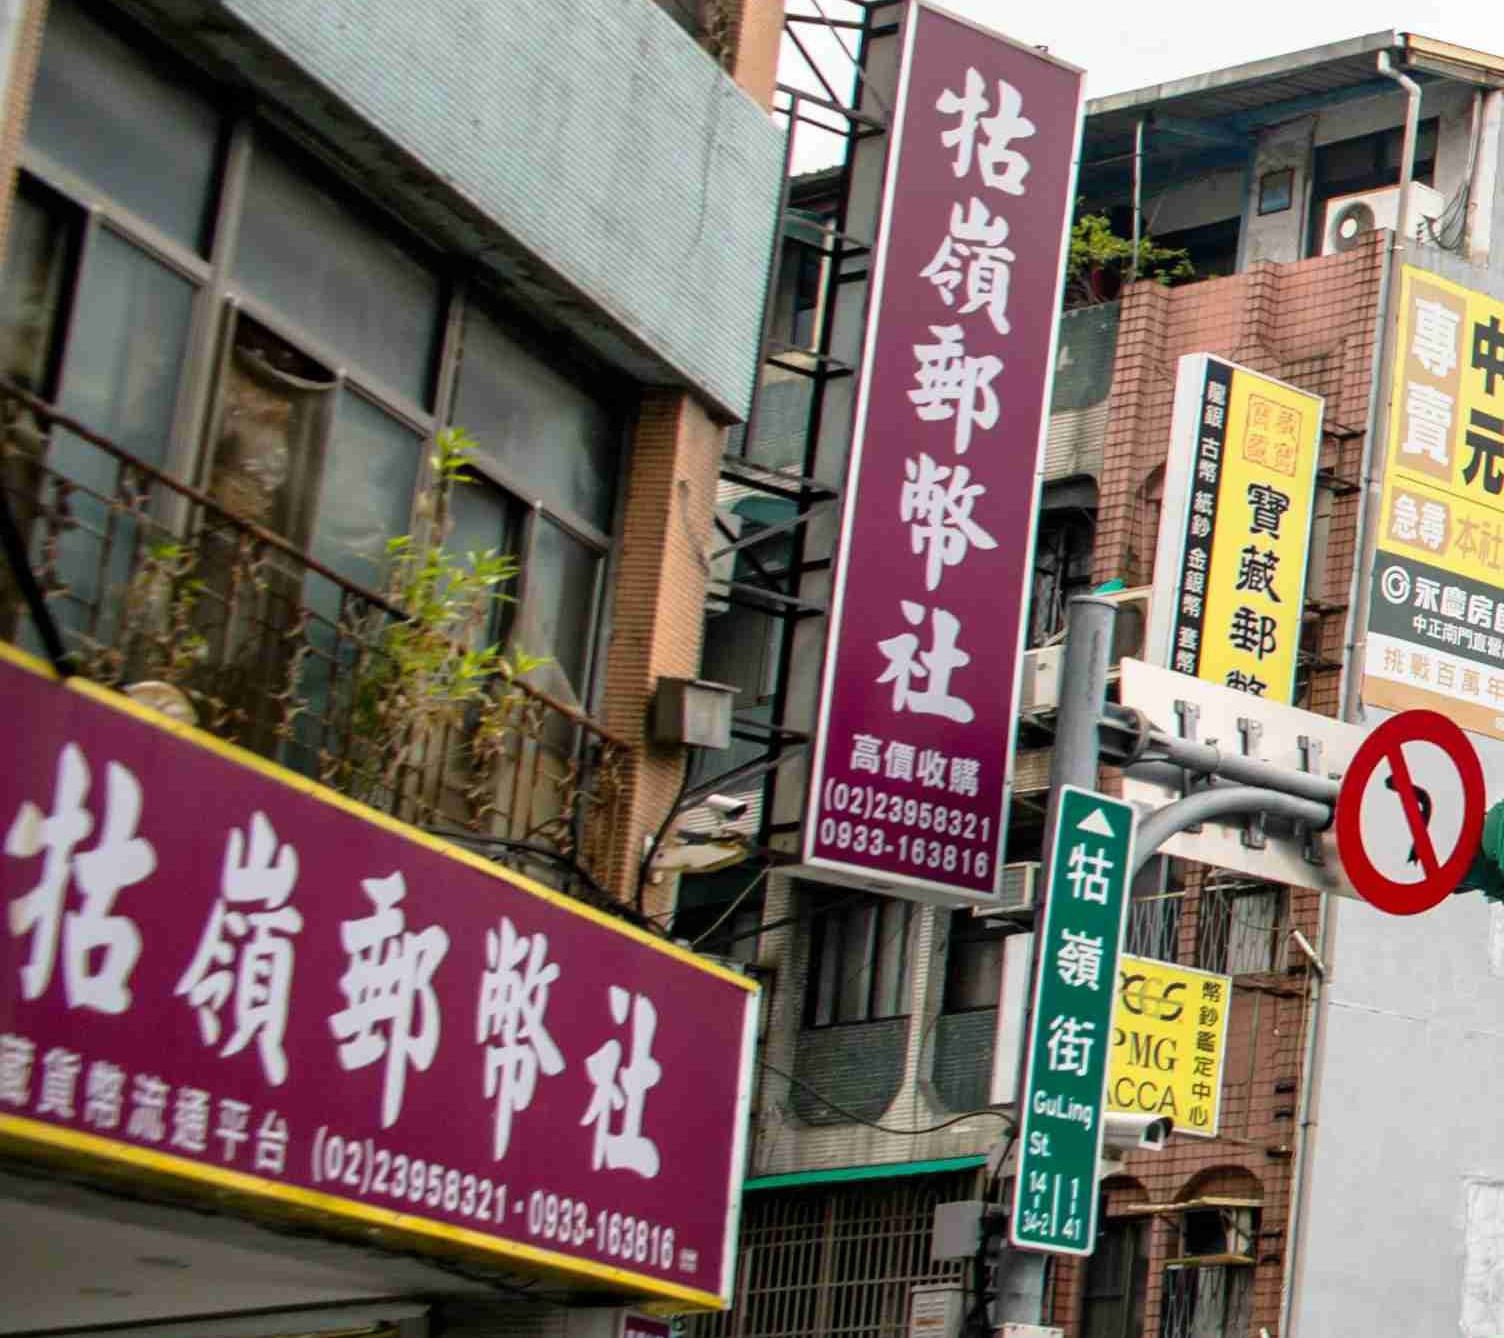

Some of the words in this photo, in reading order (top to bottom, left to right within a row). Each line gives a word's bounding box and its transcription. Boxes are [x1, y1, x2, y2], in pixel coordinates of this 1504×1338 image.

[876, 66, 1036, 724] 牯嶺郵幣社
[1401, 297, 1461, 470] 專賣
[1389, 493, 1448, 553] 急尋
[851, 733, 982, 797] 高價收購
[822, 778, 991, 841] (02)23958321
[819, 818, 989, 878] 0933-163816
[3, 743, 664, 1180] 牯嶺郵幣社
[1047, 843, 1114, 1079] 牯嶺街
[1033, 1090, 1093, 1132] GuLing
[311, 1126, 508, 1225] (02)23958321
[527, 1196, 676, 1272] 0933-163816
[1029, 1170, 1047, 1195] 14
[1061, 1216, 1081, 1242] 41
